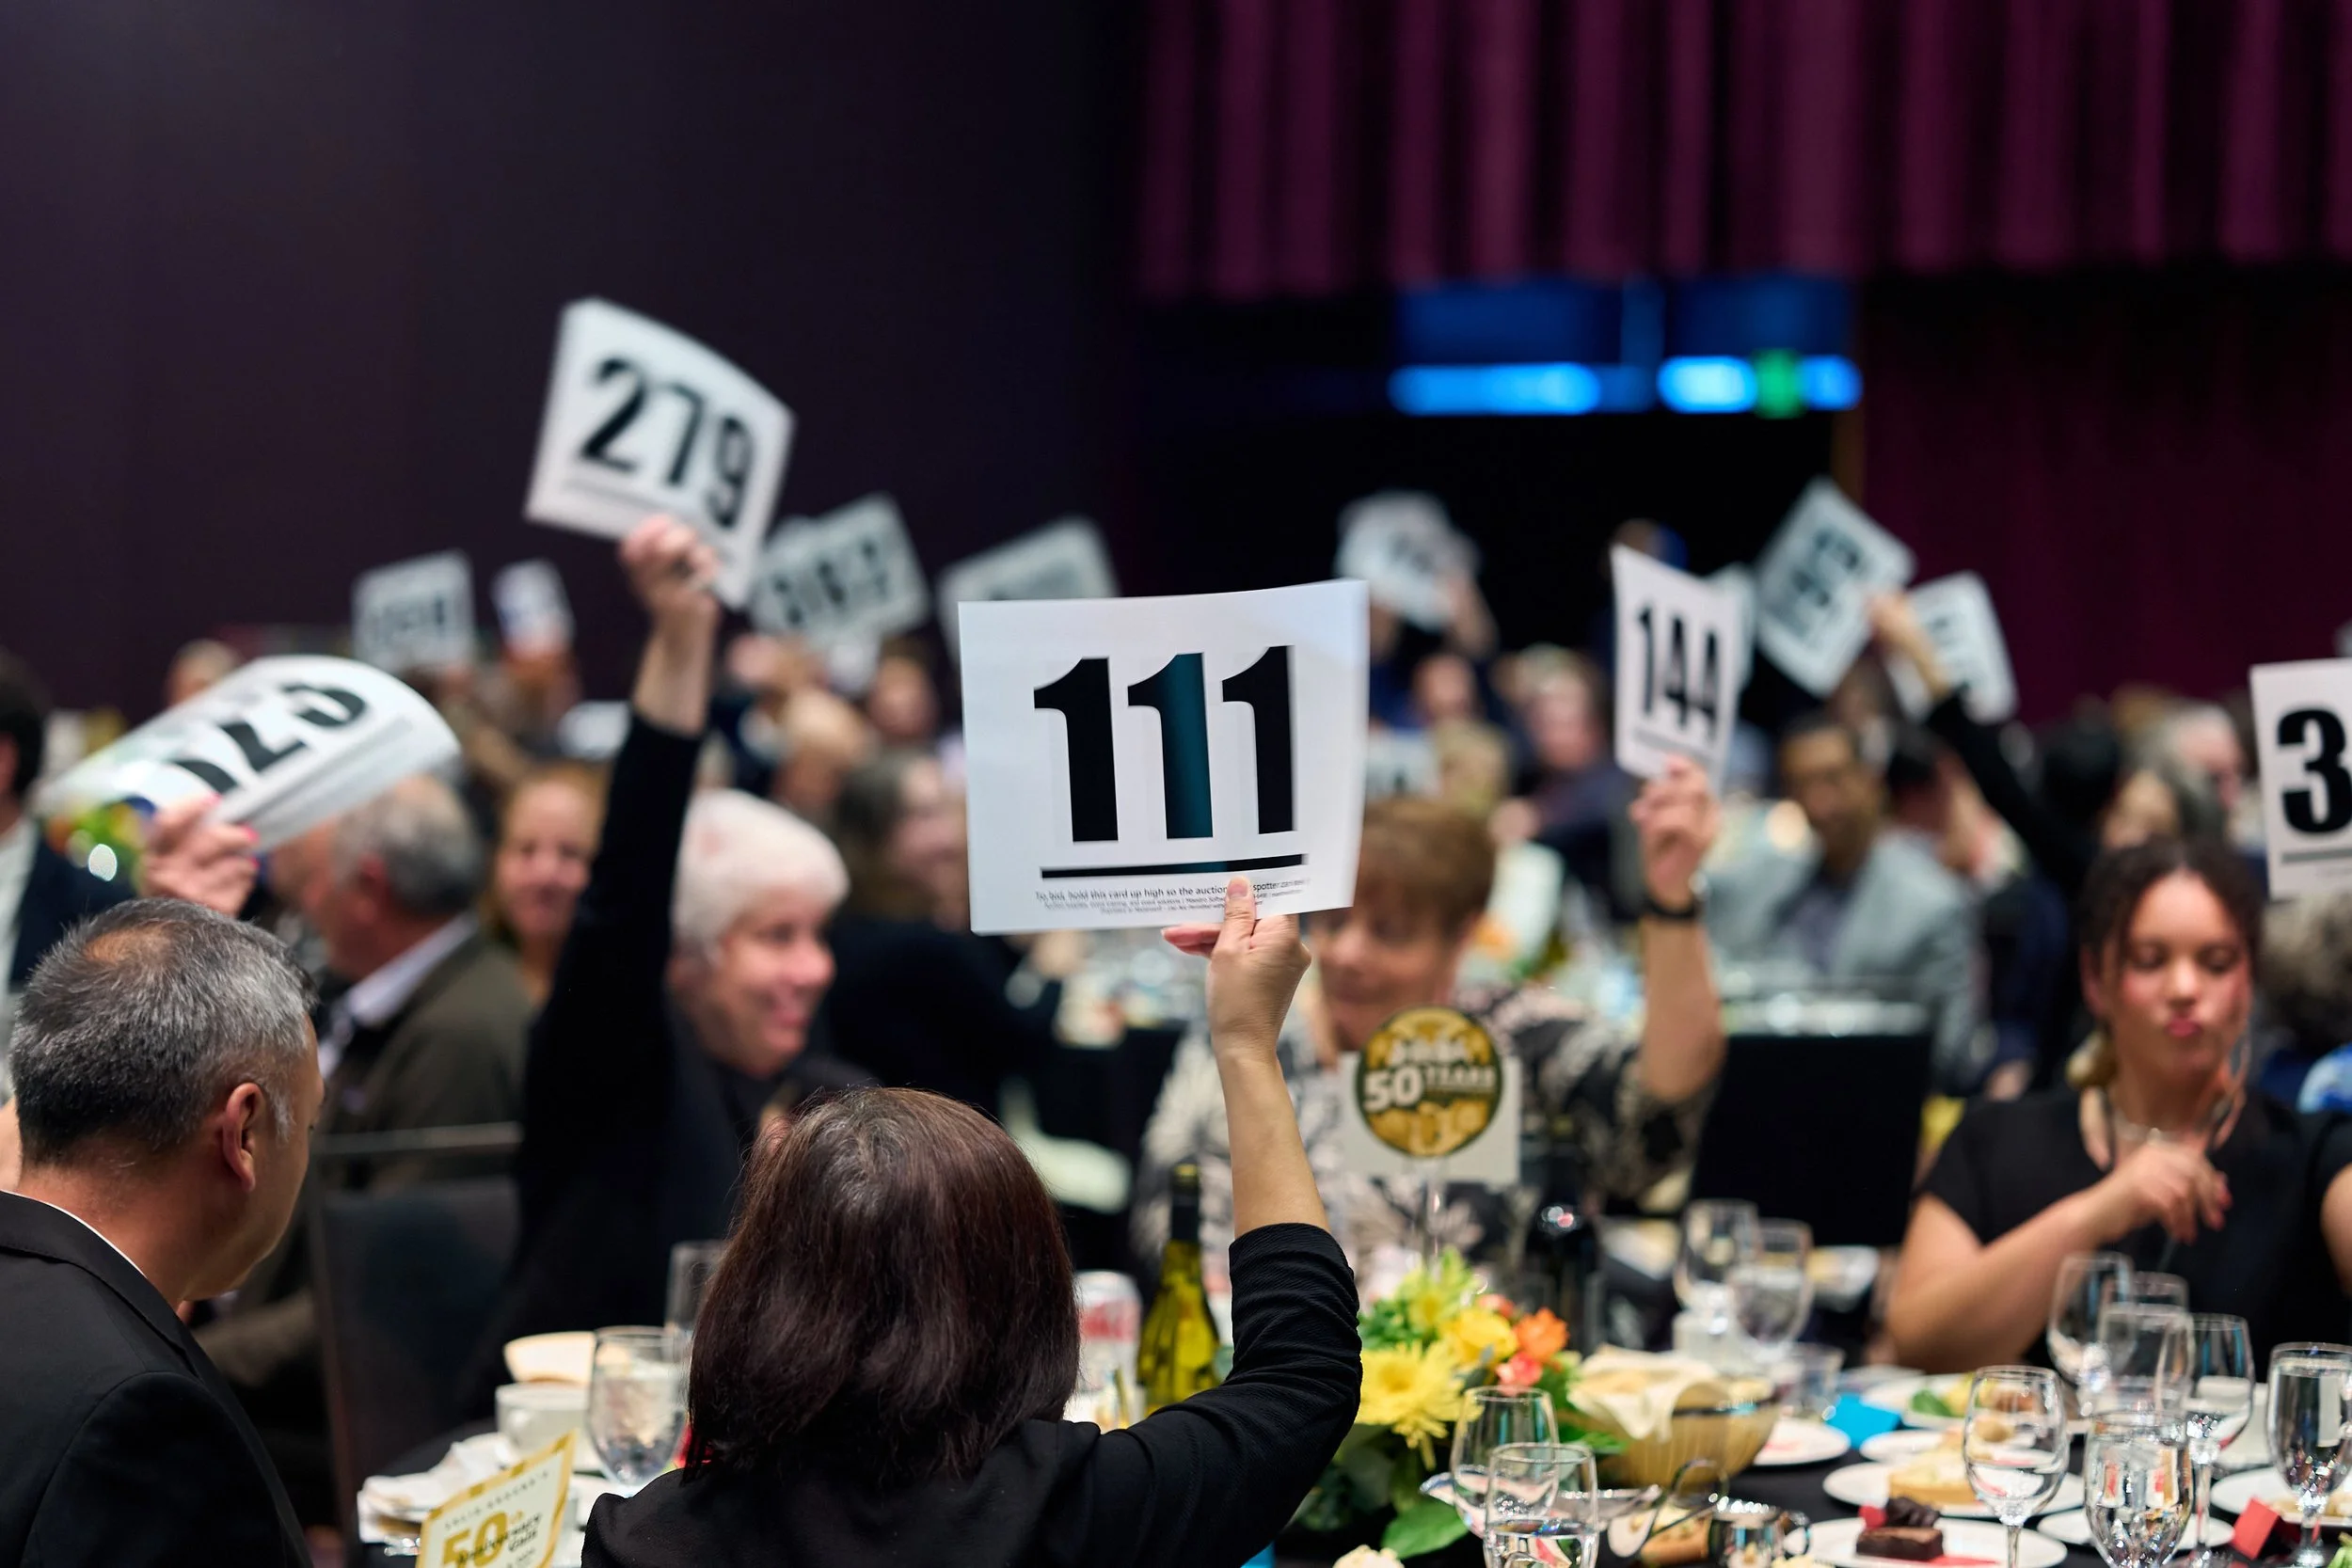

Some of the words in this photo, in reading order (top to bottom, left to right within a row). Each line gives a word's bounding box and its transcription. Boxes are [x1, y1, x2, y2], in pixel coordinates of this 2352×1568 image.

[580, 356, 755, 529] 279
[1634, 606, 1721, 743] 144
[1033, 645, 1295, 843] 111
[1130, 889, 1142, 901] up
[1144, 887, 1164, 899] high
[1167, 887, 1177, 896] so
[1179, 886, 1194, 895] the
[1252, 880, 1279, 892] spotter
[1362, 1066, 1423, 1114] 50
